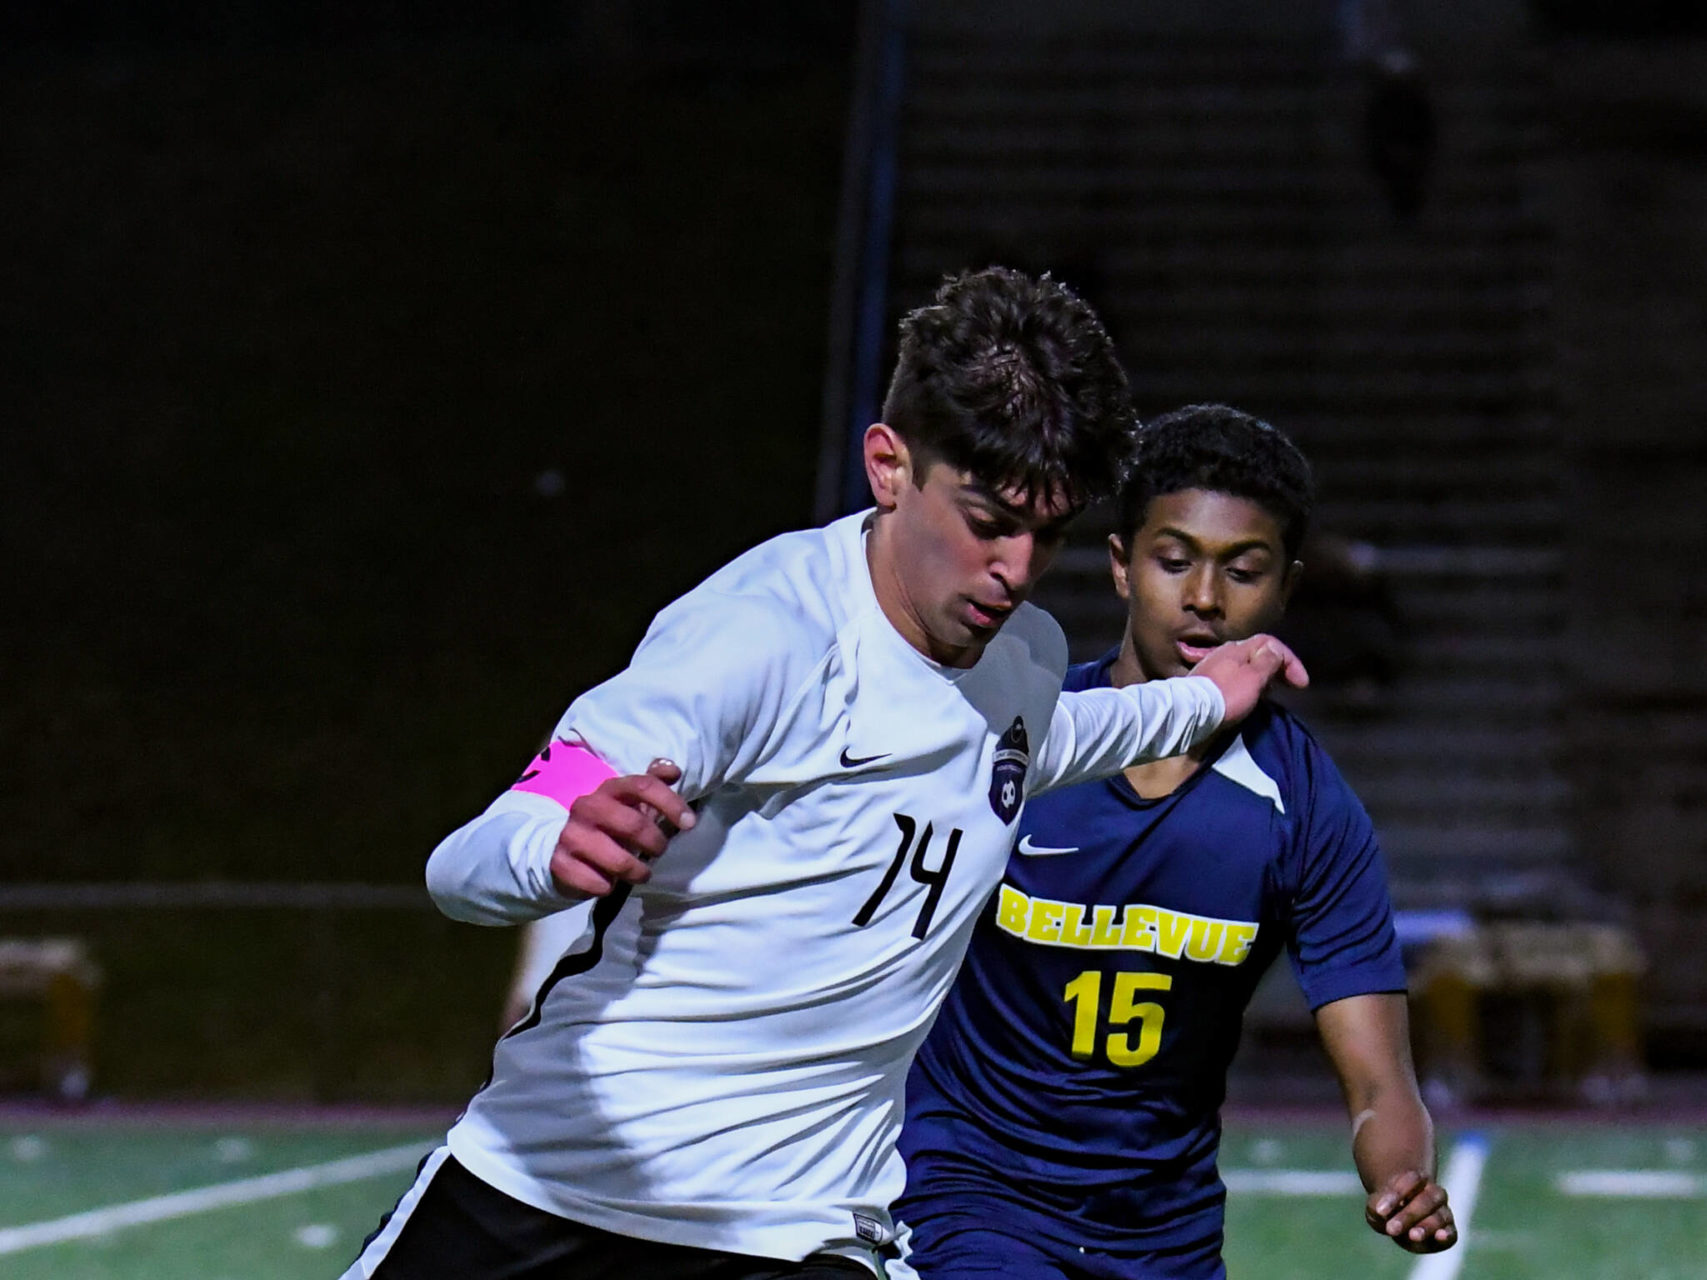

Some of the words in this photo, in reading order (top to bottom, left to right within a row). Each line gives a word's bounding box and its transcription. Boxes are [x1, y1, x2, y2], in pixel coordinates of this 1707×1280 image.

[851, 812, 963, 940] 14
[996, 883, 1260, 967] BELLEVUE
[1063, 970, 1172, 1067] 15
